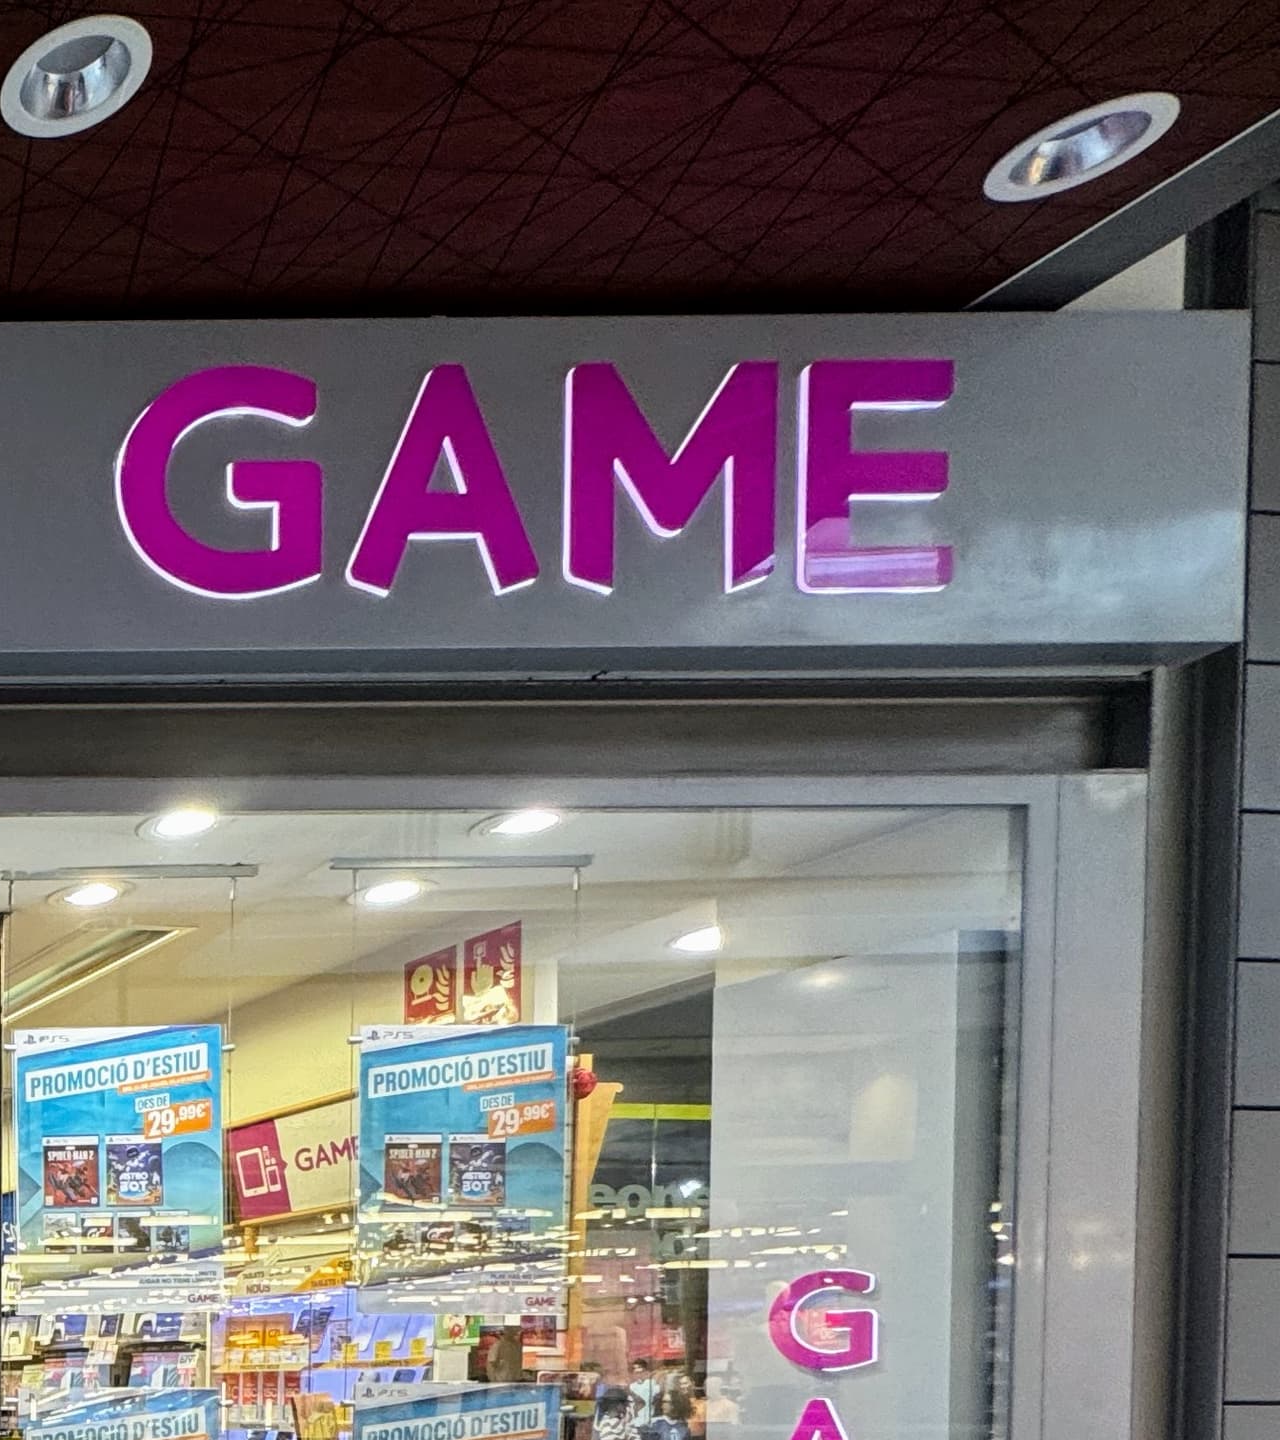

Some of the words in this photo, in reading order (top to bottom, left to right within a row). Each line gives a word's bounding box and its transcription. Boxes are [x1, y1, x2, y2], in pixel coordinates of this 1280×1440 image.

[115, 359, 954, 599] GAME
[31, 1060, 128, 1098] PROMOCIÓ
[134, 1049, 201, 1079] D'ESTIU
[374, 1057, 473, 1094] PROMOCIÓ
[478, 1049, 546, 1079] D'ESTIU
[120, 1180, 149, 1192] BOT
[462, 1180, 491, 1192] BOT
[187, 1294, 219, 1303] GAME
[525, 1297, 556, 1306] GAME
[134, 1413, 199, 1439] D'ESTIU
[470, 1408, 538, 1437] D'ESTIU
